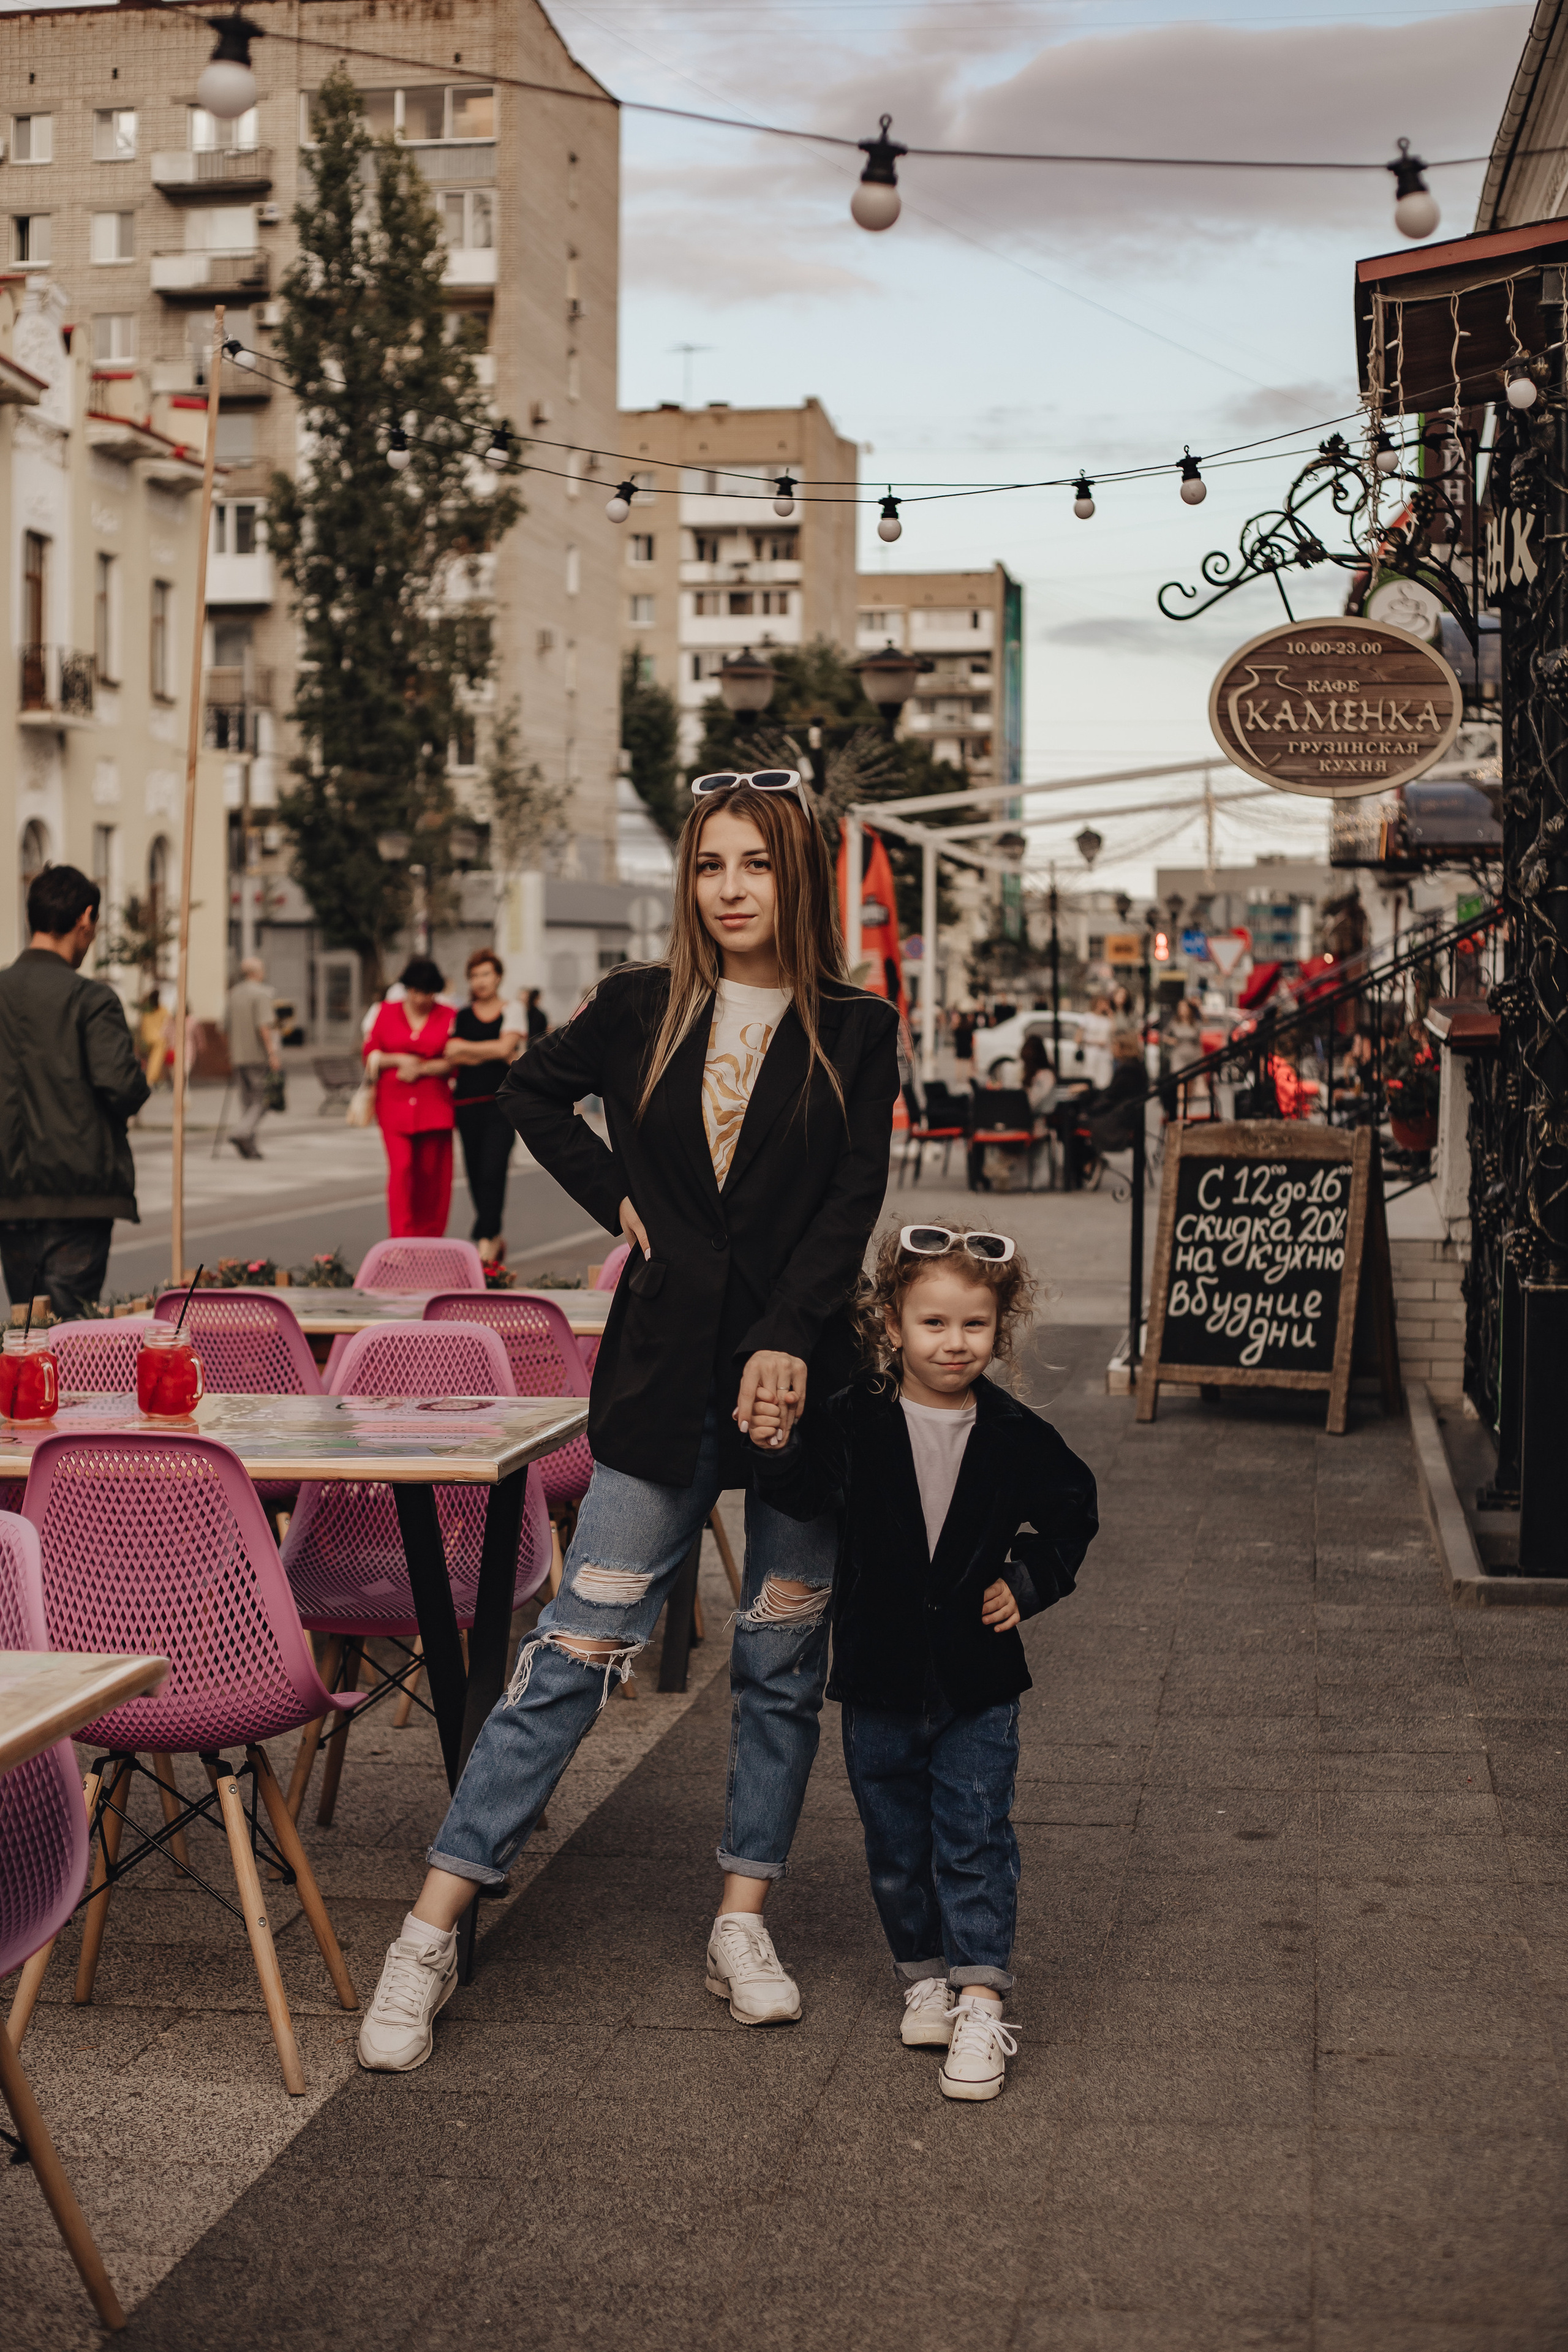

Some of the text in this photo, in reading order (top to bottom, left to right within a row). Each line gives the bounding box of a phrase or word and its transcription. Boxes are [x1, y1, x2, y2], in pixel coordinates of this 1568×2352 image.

[1286, 641, 1382, 655] 10.00-23.00
[1306, 679, 1361, 693] КАФЕ
[1245, 696, 1442, 733] КАМЕНКА
[1287, 741, 1420, 755] ГРУЗИНСКАЯ
[1319, 759, 1388, 773] КУХНЯ
[1197, 1164, 1224, 1211] С
[1268, 1181, 1307, 1218] до
[1175, 1205, 1348, 1267] скидка 20%
[1175, 1243, 1346, 1285] на кухню
[1239, 1317, 1317, 1366] дни
